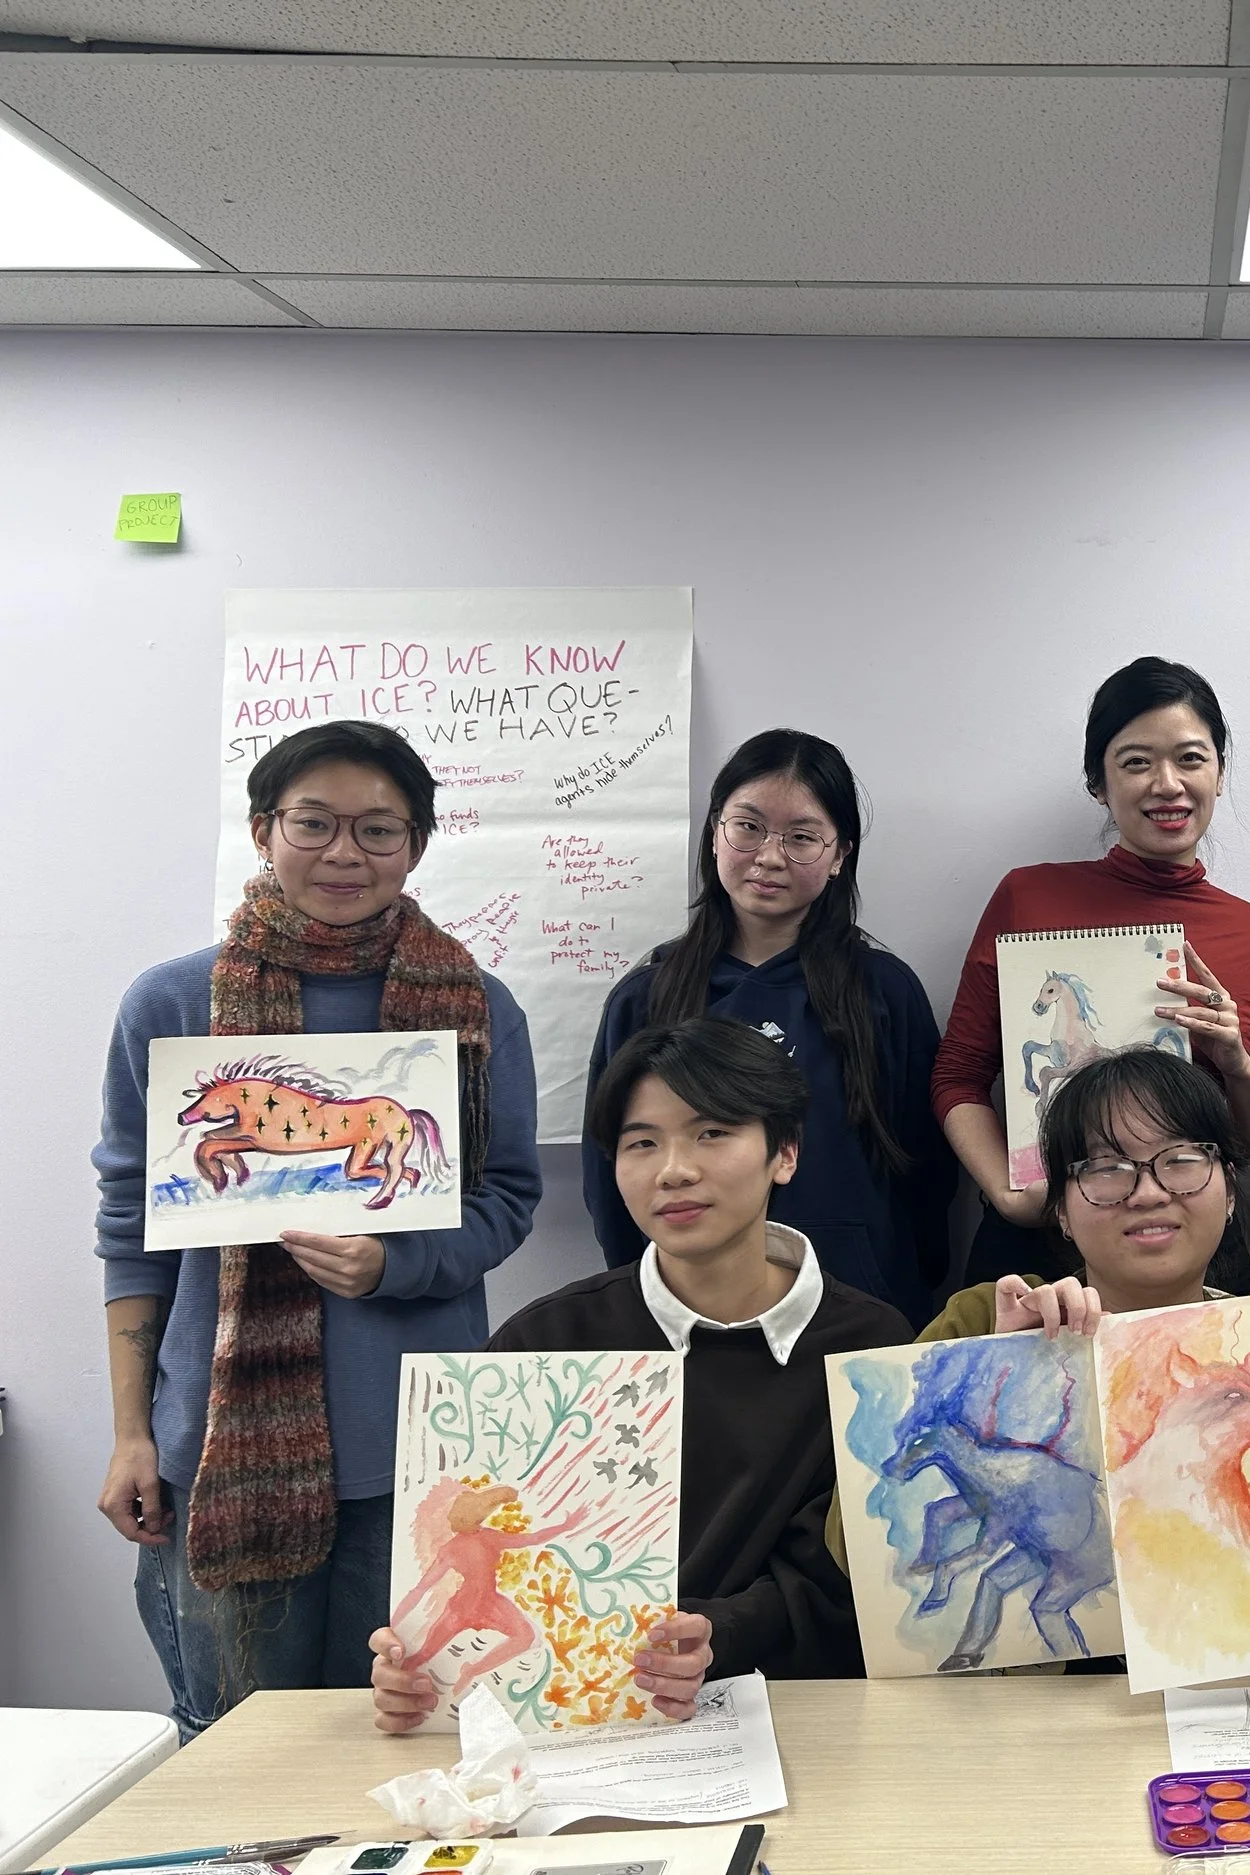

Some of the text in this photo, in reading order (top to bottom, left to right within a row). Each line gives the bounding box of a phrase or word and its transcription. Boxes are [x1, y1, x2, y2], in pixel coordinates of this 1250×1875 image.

[126, 495, 177, 514] GROUP
[119, 514, 179, 532] PROJECT
[244, 640, 626, 685] WHAT DO WE KNOW
[234, 680, 639, 728] ABOUT ICE? WHAT QUE-
[425, 719, 479, 744] WE
[499, 711, 618, 741] HAVE?
[578, 766, 591, 780] do
[590, 752, 615, 775] ICE
[555, 784, 595, 809] agents
[595, 768, 618, 788] hide
[450, 808, 479, 821] funds
[442, 821, 480, 836] ICE?
[542, 835, 562, 849] Are
[554, 841, 604, 859] allowed
[546, 857, 640, 874] to keep their
[560, 872, 605, 886] identity
[542, 920, 572, 934] What
[578, 922, 601, 931] can
[558, 936, 573, 947] do
[550, 947, 620, 965] protect my
